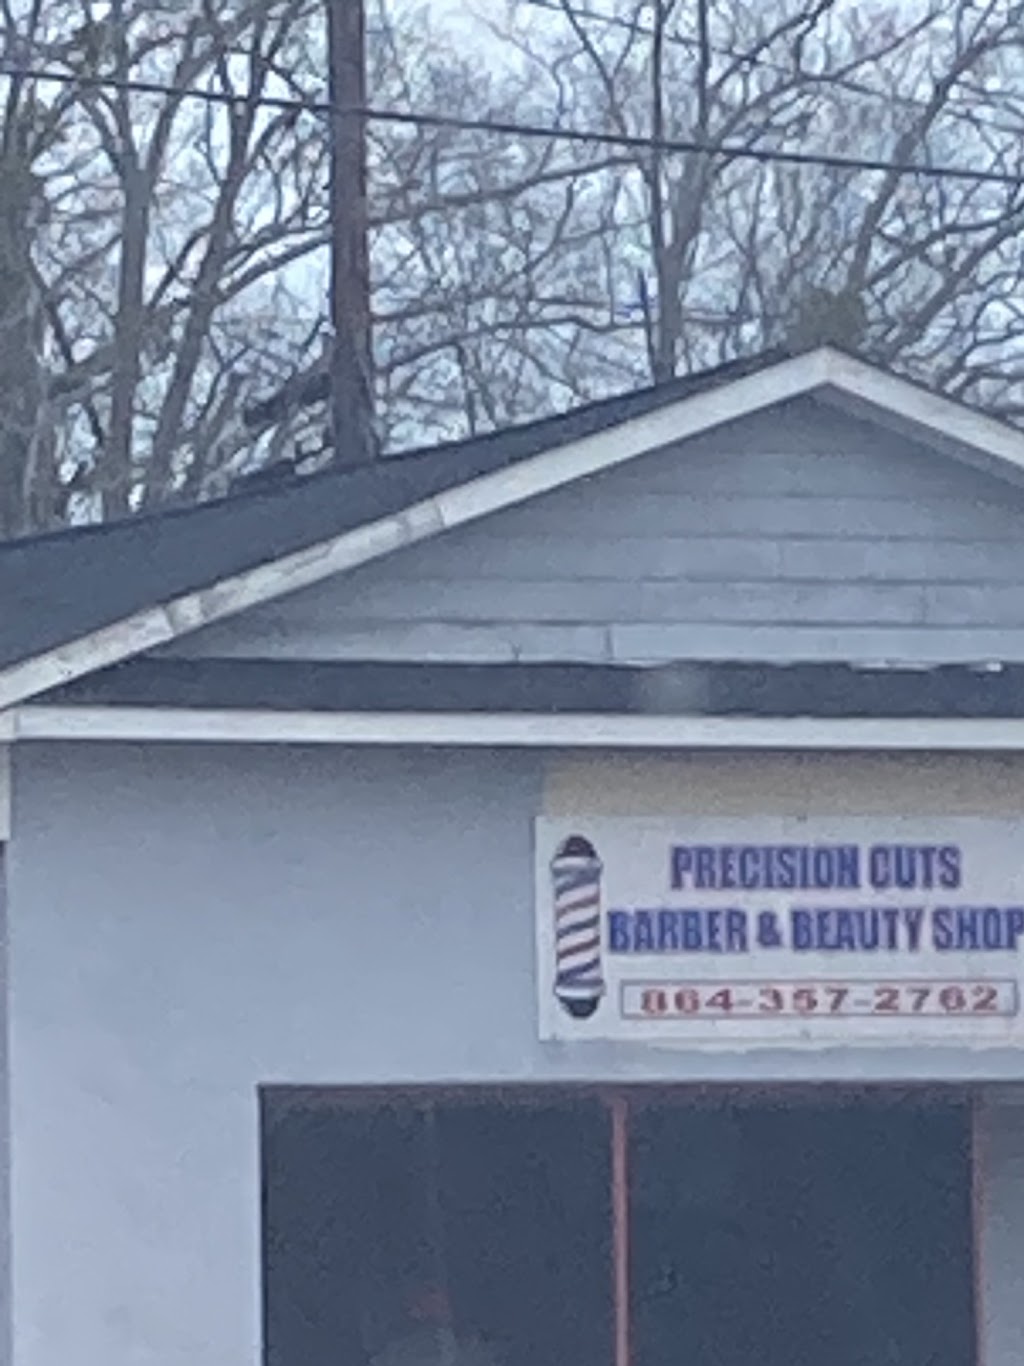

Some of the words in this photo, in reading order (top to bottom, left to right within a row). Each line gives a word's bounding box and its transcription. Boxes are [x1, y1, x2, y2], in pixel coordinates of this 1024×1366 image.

[670, 845, 860, 890] PRECISION
[869, 845, 961, 890] CUTS
[607, 909, 749, 954] BARBER
[755, 911, 783, 951] &
[791, 908, 926, 952] BEAUTY
[640, 988, 999, 1014] 864-357-2762
